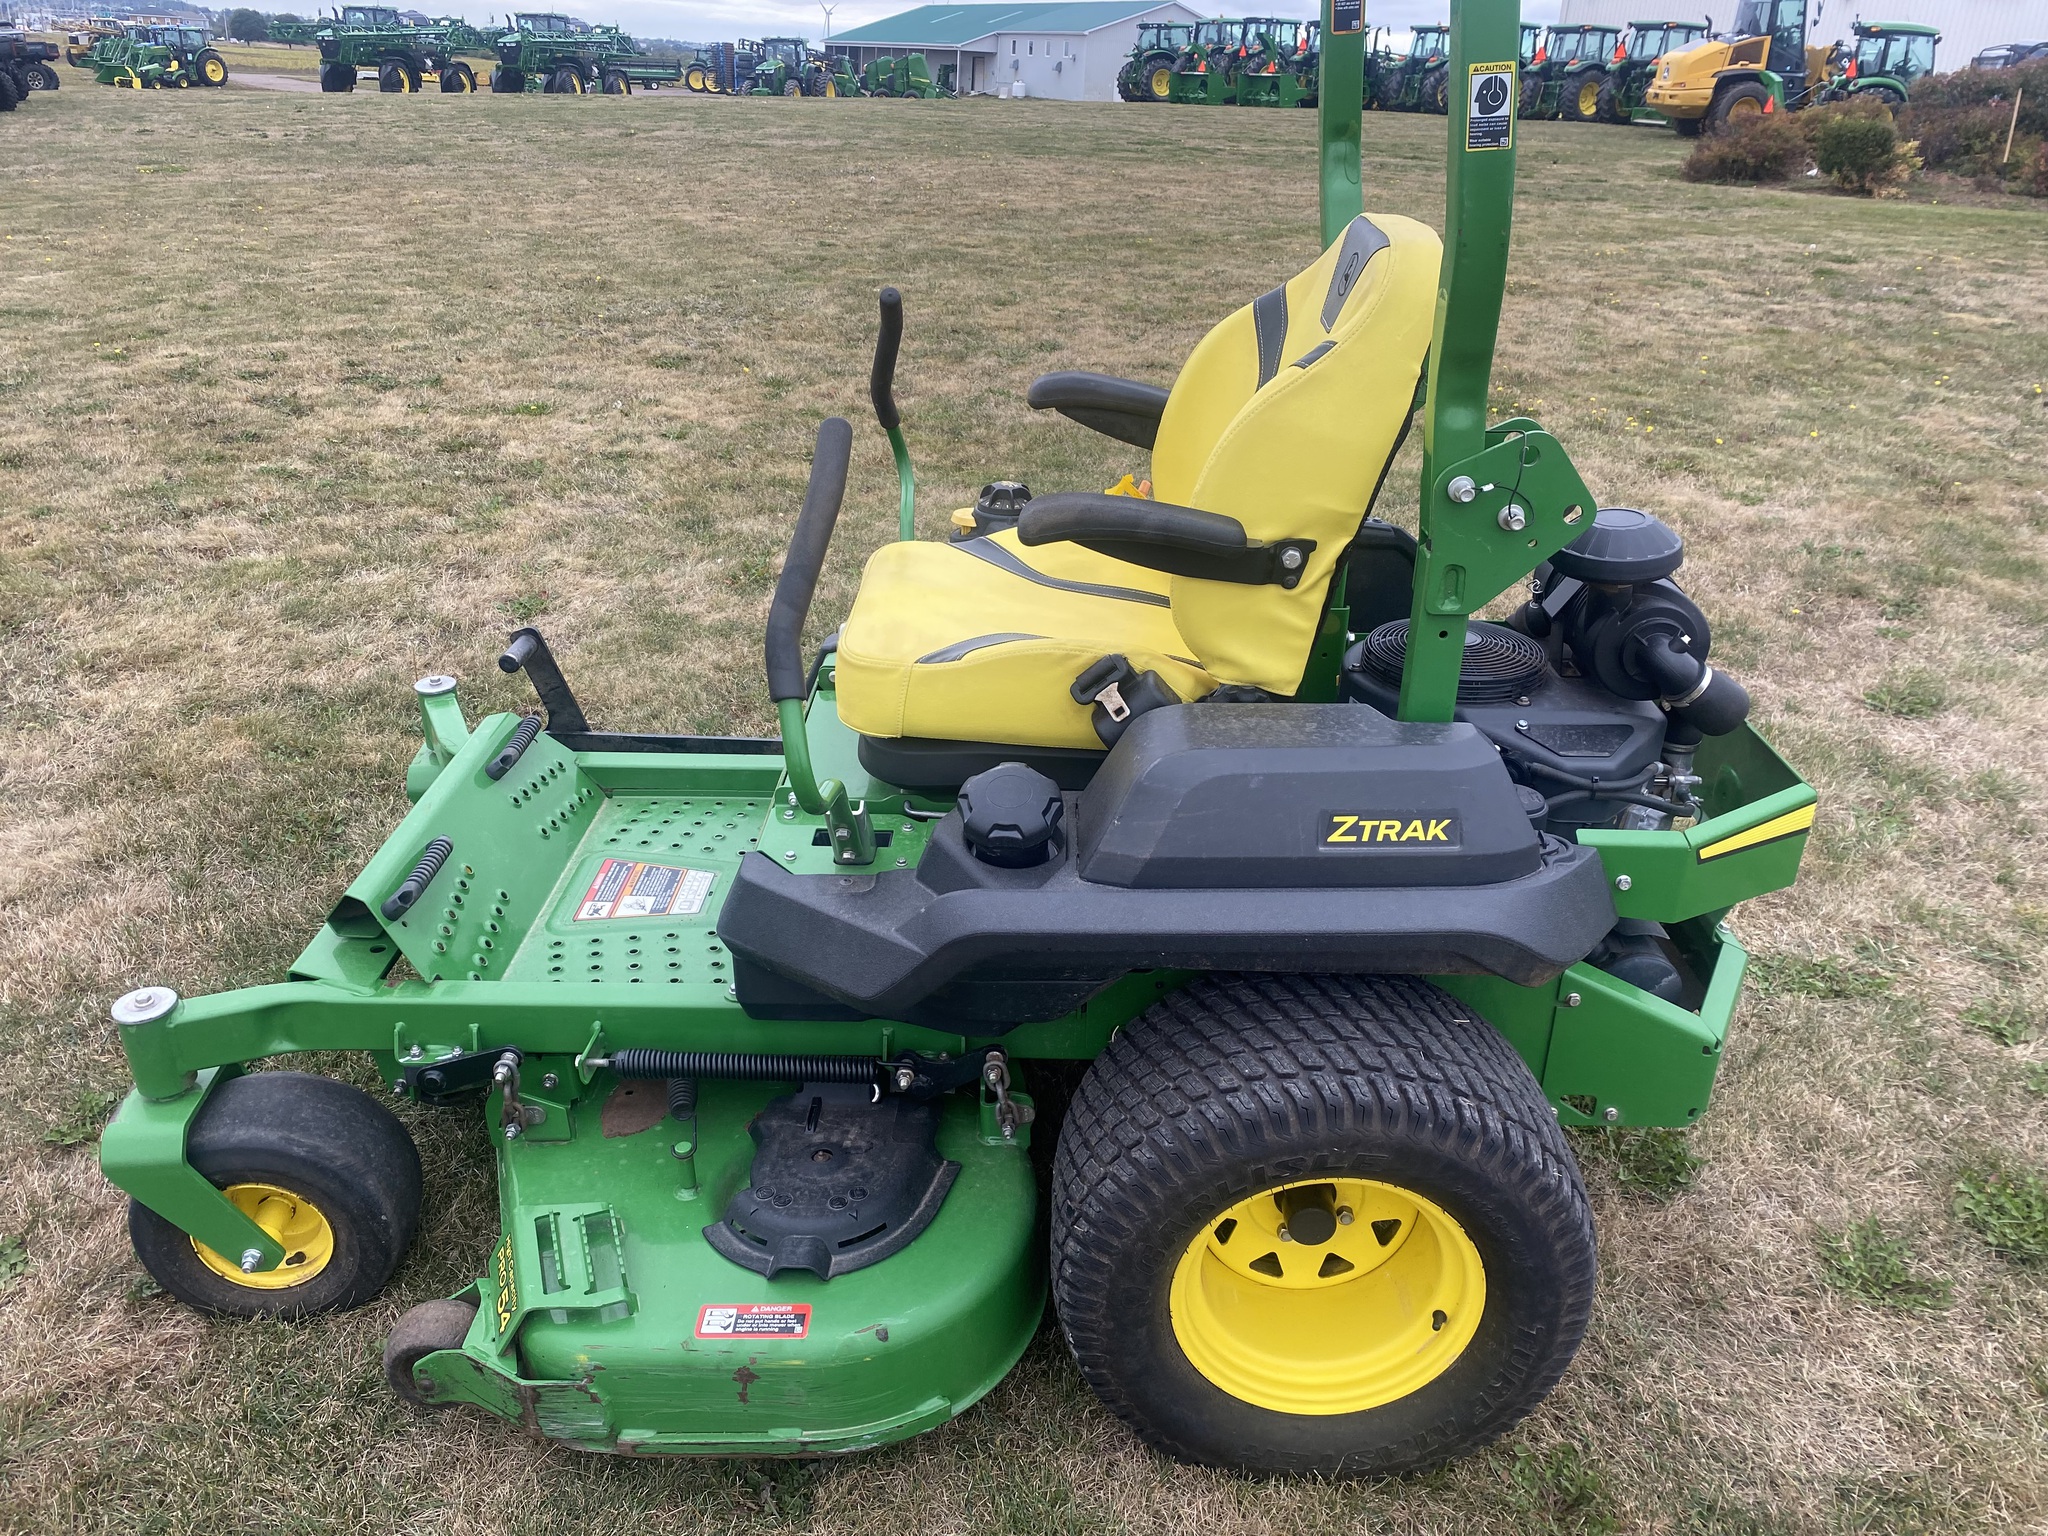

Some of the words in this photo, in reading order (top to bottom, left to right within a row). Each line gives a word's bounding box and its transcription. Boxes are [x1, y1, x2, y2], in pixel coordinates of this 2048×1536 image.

[1479, 64, 1512, 72] CAUTION
[1326, 815, 1452, 842] ZTRAK
[1134, 1152, 1389, 1275] CARLISLE
[497, 1246, 507, 1287] PRO
[508, 1260, 518, 1312] Capacity
[497, 1285, 511, 1334] 54
[1474, 1324, 1545, 1425] TURF
[1241, 1416, 1461, 1471] MASTER
